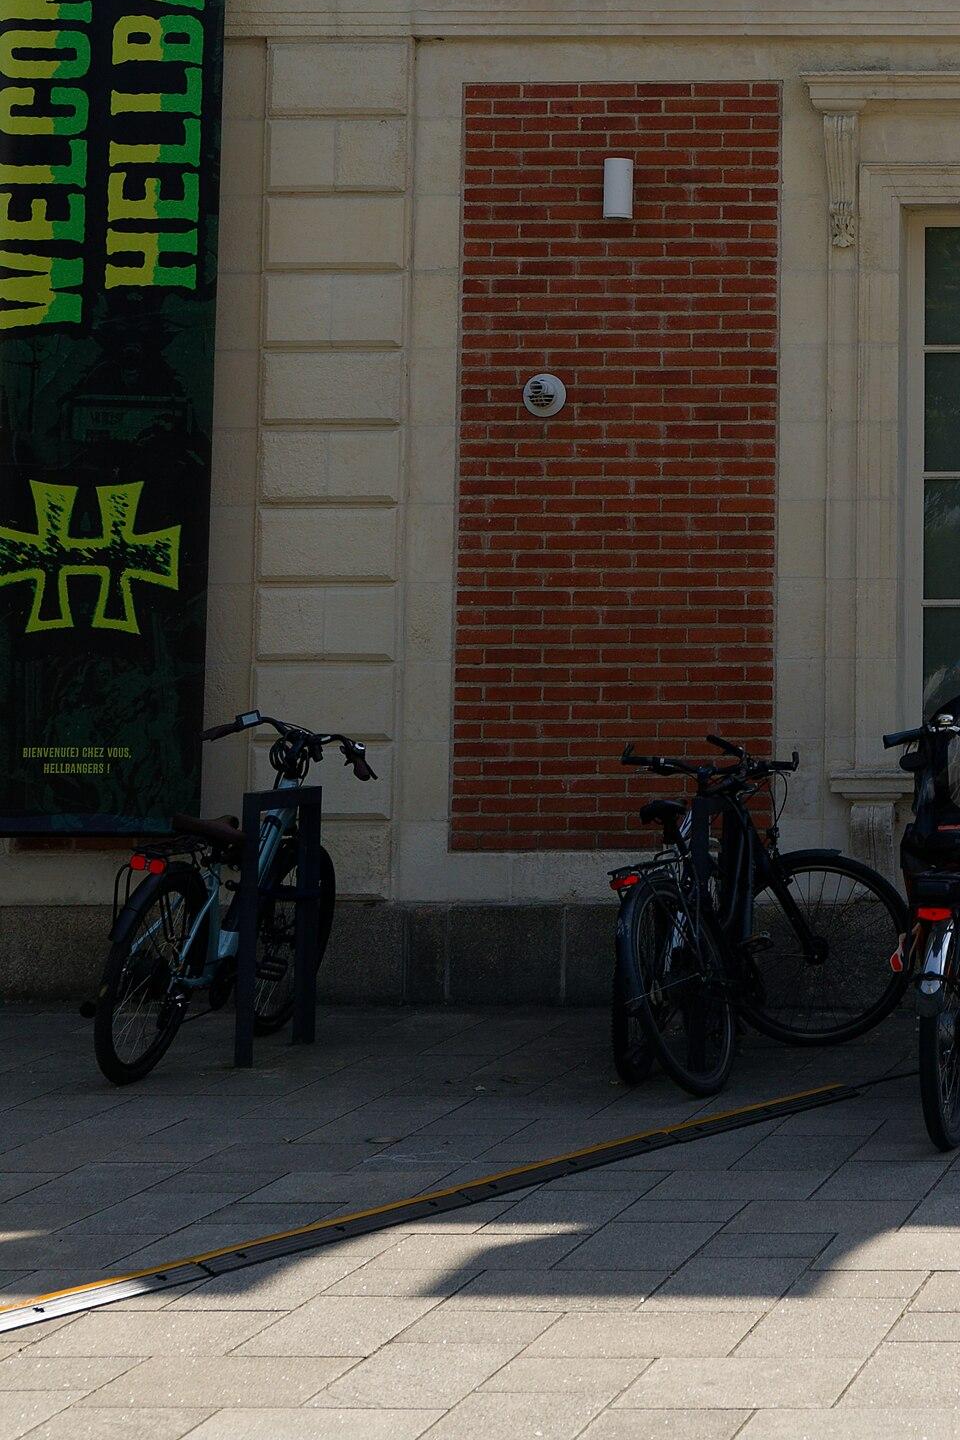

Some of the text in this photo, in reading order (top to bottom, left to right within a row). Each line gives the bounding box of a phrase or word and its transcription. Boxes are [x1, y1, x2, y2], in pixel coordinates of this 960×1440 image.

[22, 747, 132, 759] BIENVENU(E) CHEZ VOUS,
[43, 763, 111, 774] HELLBANGERS !
